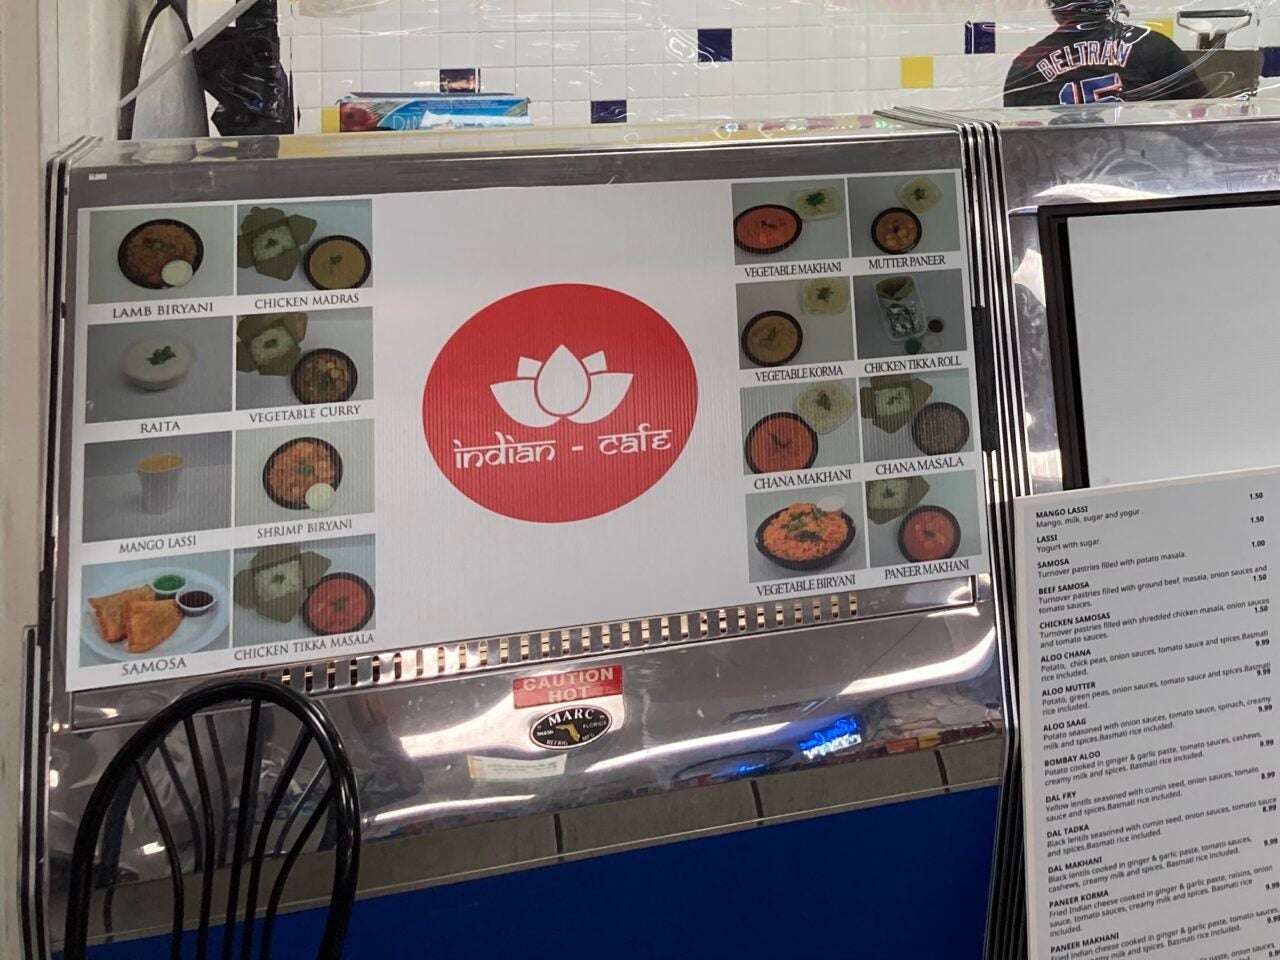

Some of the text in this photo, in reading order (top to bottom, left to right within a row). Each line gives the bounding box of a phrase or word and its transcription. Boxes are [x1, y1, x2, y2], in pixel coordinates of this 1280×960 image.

[1059, 73, 1124, 105] 15
[744, 262, 842, 278] VEGETABLE MAKHANI
[869, 254, 946, 270] MUTTER PANEER
[254, 293, 360, 310] CHICKEN MADRAS
[112, 302, 214, 319] LAMB BIRYANI
[864, 356, 962, 374] CHICKEN TIKKA ROLL
[755, 365, 844, 383] VEGETABLE KORMA
[248, 404, 361, 424] VEGETABLE CURRY
[139, 420, 182, 434] RAITA
[454, 433, 556, 469] indian
[599, 423, 672, 457] cafe
[875, 457, 964, 475] CHANA MASALA
[754, 469, 851, 490] CHANA MAKHANI
[1249, 492, 1263, 500] 1.50
[1036, 505, 1088, 519] MANGO LASSI
[1036, 518, 1063, 529] Mango,
[1065, 516, 1081, 524] milk,
[1083, 513, 1103, 524] sugar
[1105, 511, 1119, 519] and
[1250, 516, 1264, 524] 1.50
[257, 519, 354, 540] SHRIMP BIRYANI
[119, 535, 197, 555] MANGO LASSI
[1036, 534, 1058, 543] LASSI
[1037, 538, 1101, 554] Yogurt with sugar.
[1251, 539, 1266, 548] 1.00
[884, 560, 970, 580] PANEER MAKHANI
[1037, 558, 1070, 568] SAMOSA
[756, 574, 856, 597] VEGETABLE BIRYANI
[1038, 581, 1090, 595] BEEF SAMOSA
[1039, 612, 1111, 629] CHICKEN SAMOSAS
[234, 634, 375, 662] CHICKEN TIKKA MASALA
[1041, 649, 1091, 663] ALOO CHANA
[121, 657, 188, 677] SAMOSA
[523, 667, 614, 691] CAUTION
[548, 686, 590, 703] HOT
[548, 708, 594, 727] MARC
[1044, 751, 1101, 767] BOMBAY ALOO
[1045, 791, 1077, 803] DAL FRY
